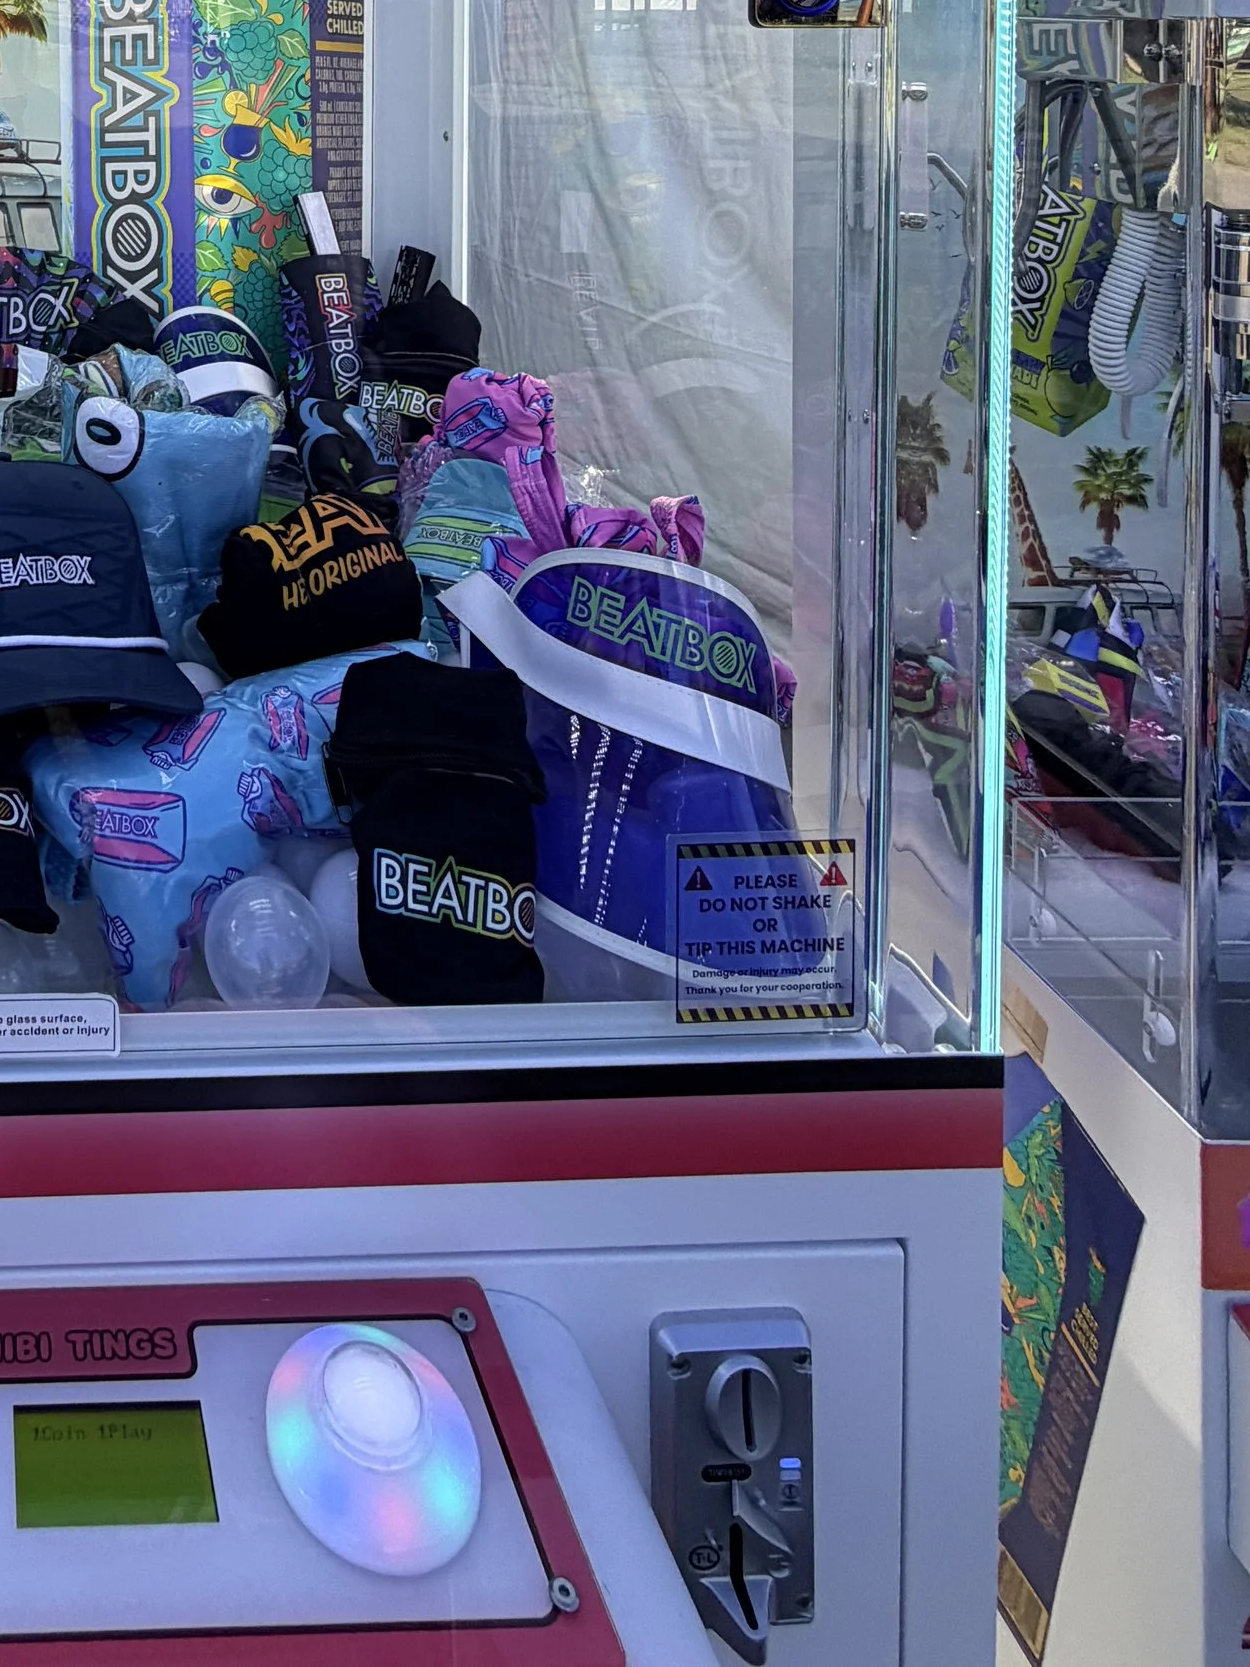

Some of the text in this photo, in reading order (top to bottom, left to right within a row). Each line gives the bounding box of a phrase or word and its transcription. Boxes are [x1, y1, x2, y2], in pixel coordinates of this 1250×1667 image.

[326, 0, 363, 17] SERVED
[325, 18, 364, 35] CHILLED
[318, 274, 362, 397] BEATBOX
[160, 330, 254, 365] EATBOX
[361, 384, 445, 424] BEATBO
[309, 540, 404, 597] ORIGINAL
[567, 576, 758, 693] BEATBOX
[95, 810, 155, 837] EATBOX
[734, 873, 798, 890] PLEASE
[379, 855, 537, 938] BEATBO
[699, 894, 832, 913] DO NOT SHAKE
[752, 917, 778, 933] OR
[685, 937, 846, 957] TIP THIS MACHINE
[692, 965, 838, 980] Damage or injury may occur.
[686, 980, 844, 997] Thank you for your cooperation.
[7, 1014, 38, 1027] glass
[40, 1014, 88, 1025] surface,
[10, 1025, 60, 1036] accident
[62, 1026, 74, 1035] or
[65, 1328, 179, 1363] TINGS
